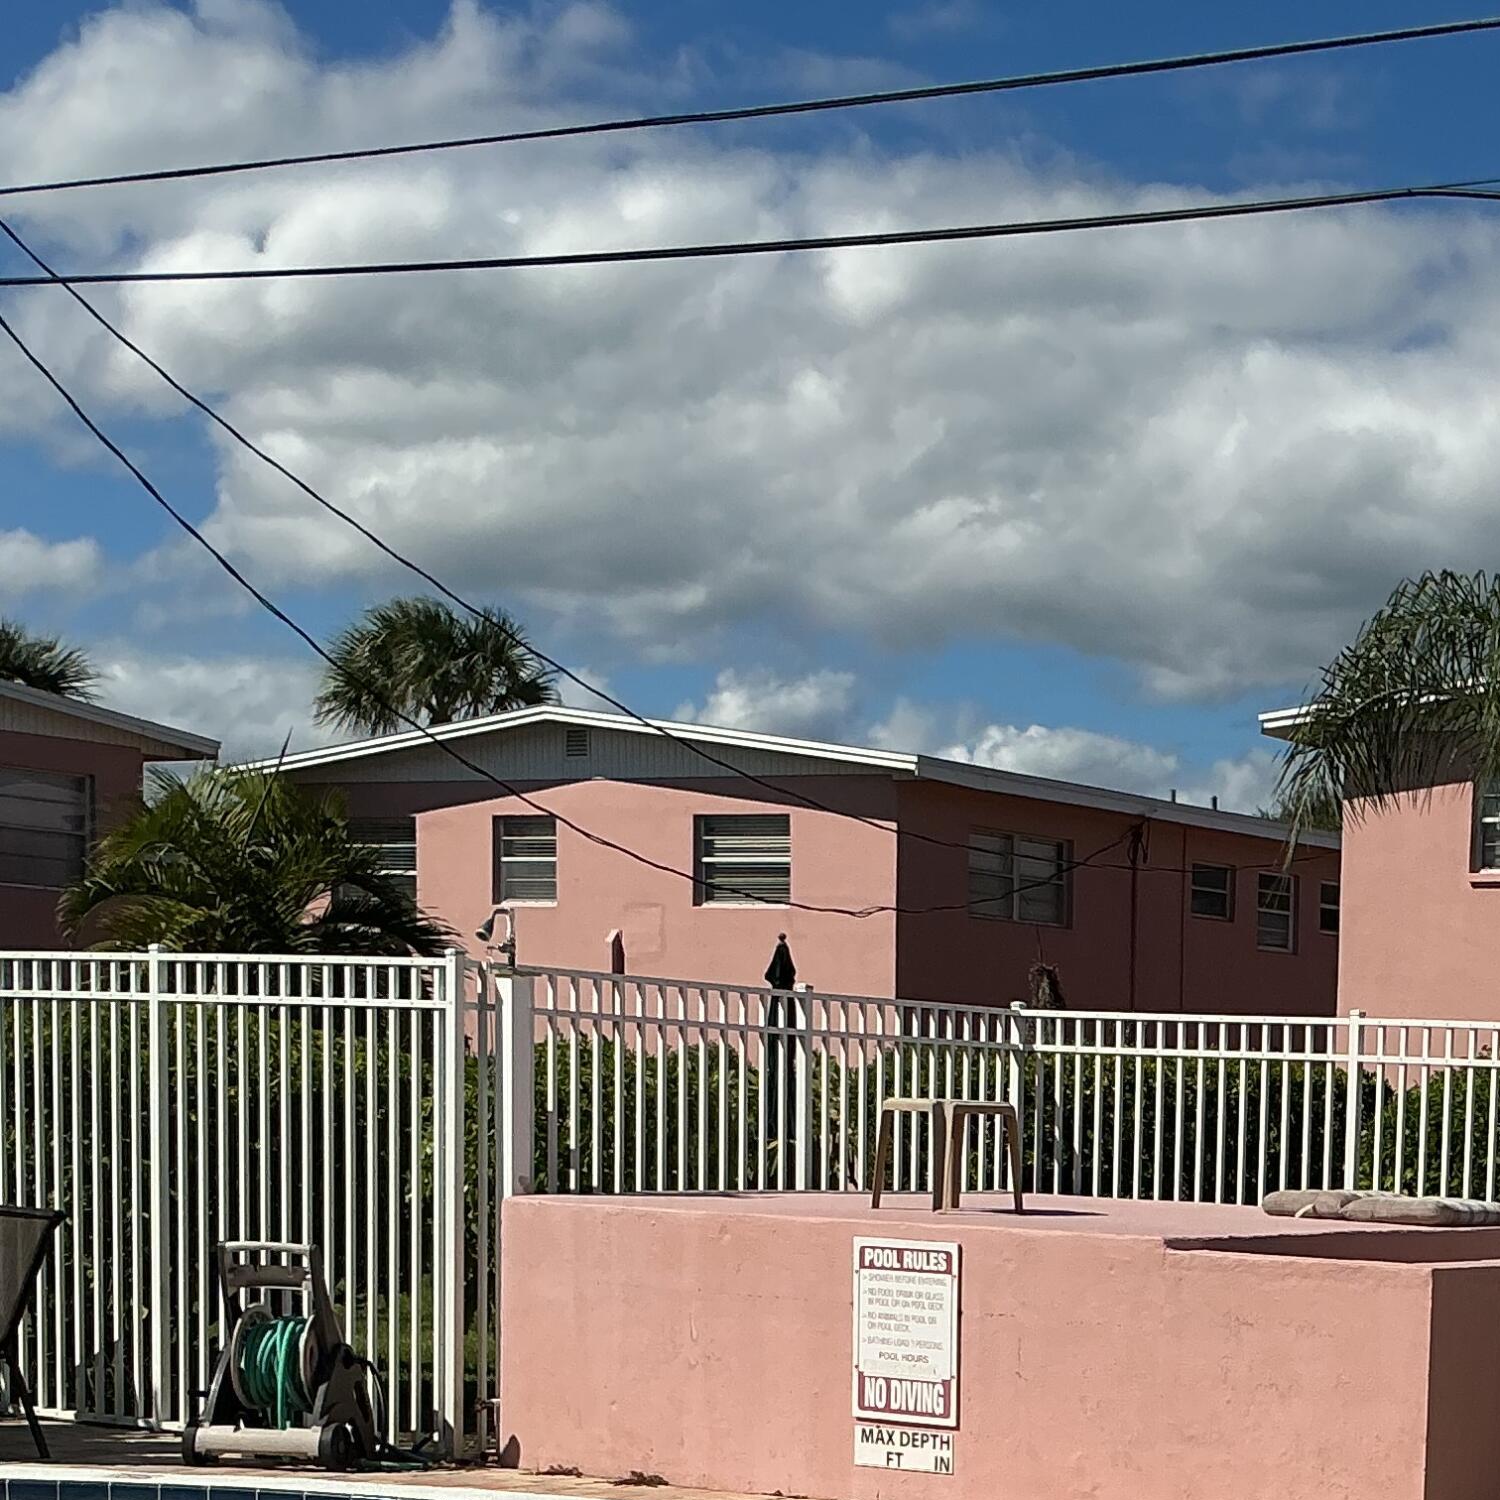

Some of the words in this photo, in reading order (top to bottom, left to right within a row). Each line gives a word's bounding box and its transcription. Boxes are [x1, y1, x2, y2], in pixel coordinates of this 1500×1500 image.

[864, 1247, 900, 1269] POOL
[903, 1250, 948, 1272] RULES
[879, 1351, 899, 1361] POOL
[901, 1354, 929, 1364] HOURS
[864, 1376, 887, 1409] NO
[890, 1379, 944, 1416] DIVING
[861, 1428, 896, 1446] MAX
[900, 1431, 950, 1451] DEPTH
[886, 1451, 904, 1467] FT
[934, 1455, 950, 1472] IN
